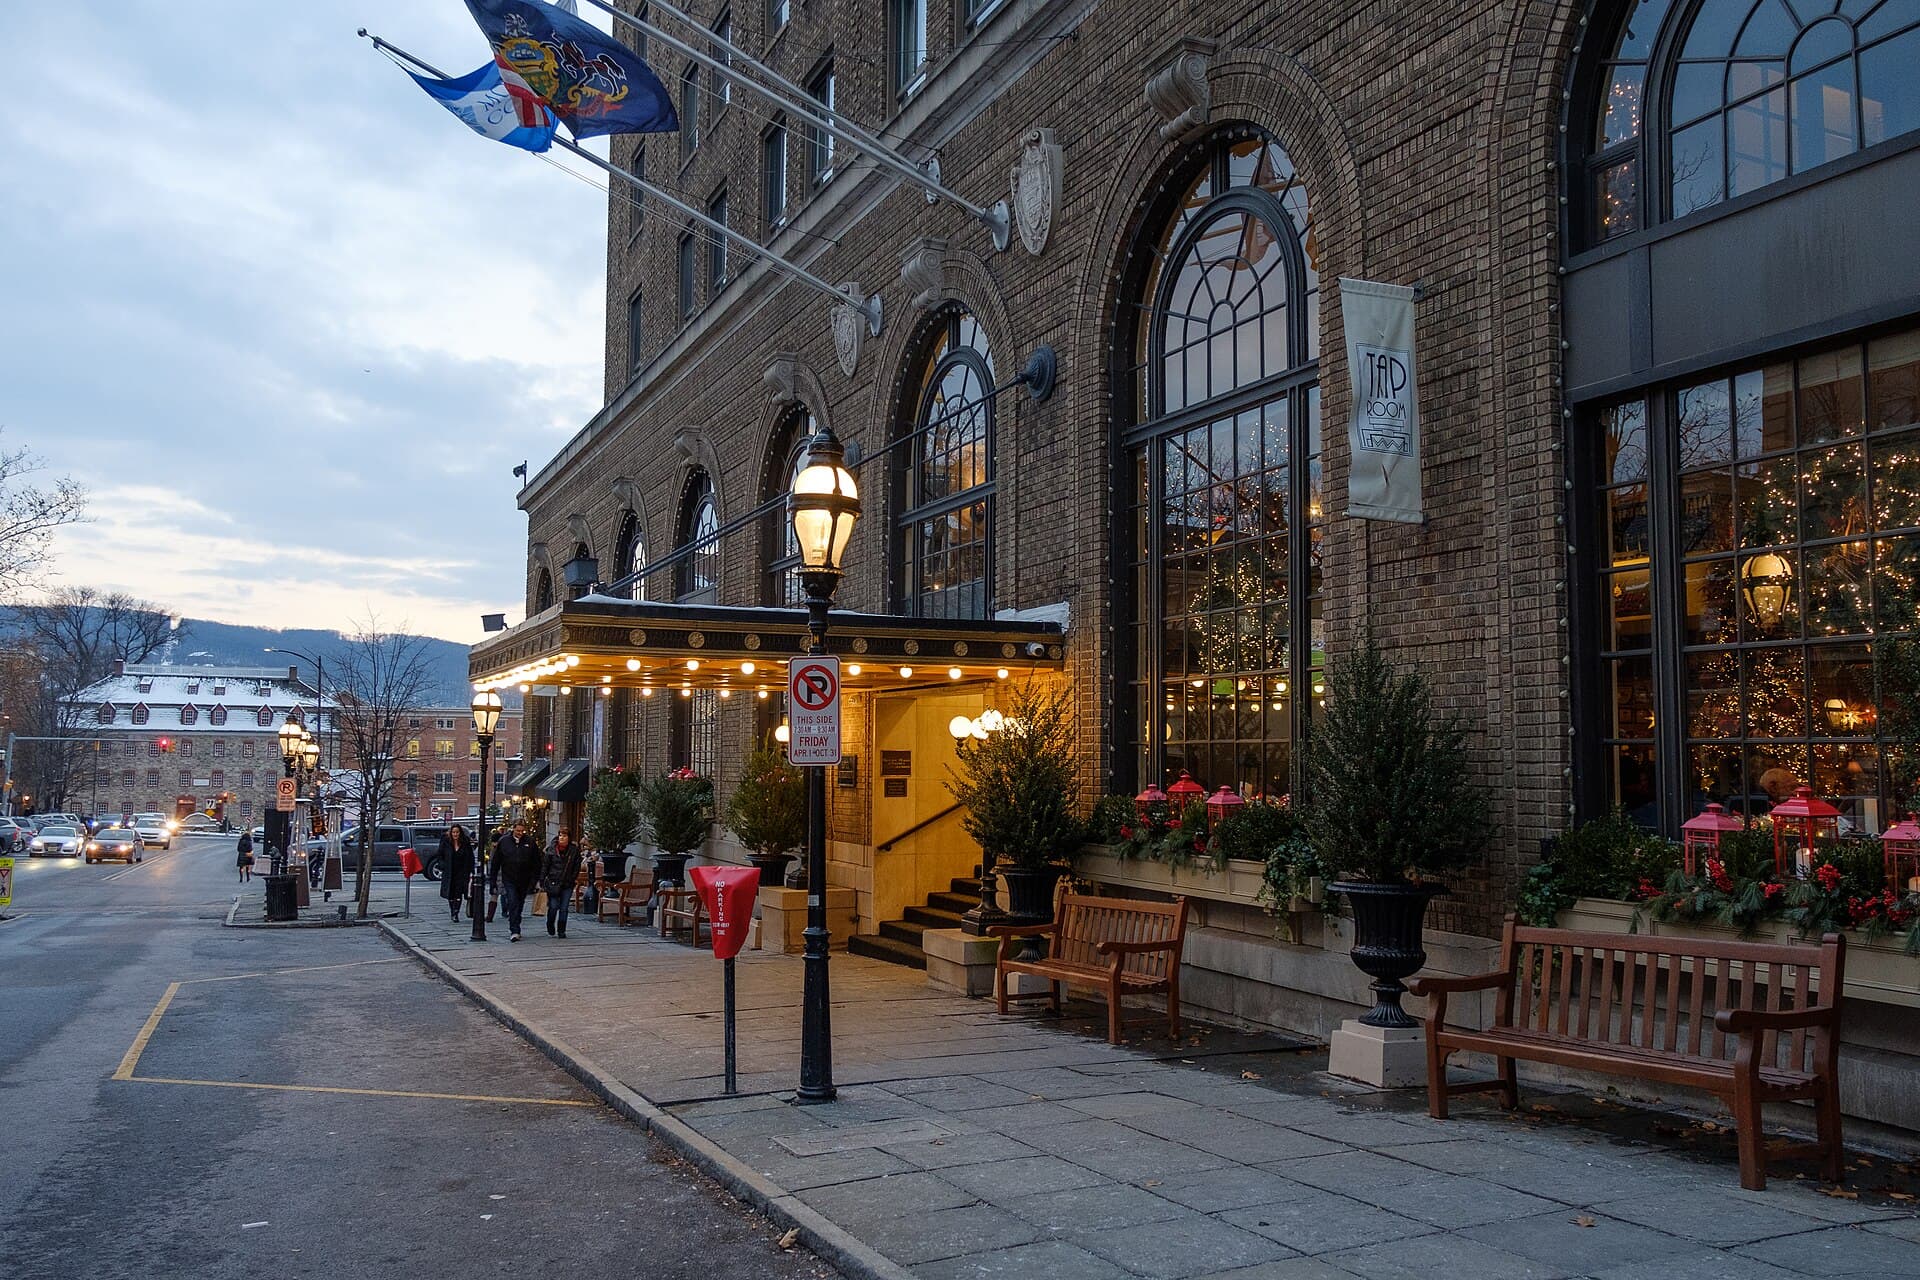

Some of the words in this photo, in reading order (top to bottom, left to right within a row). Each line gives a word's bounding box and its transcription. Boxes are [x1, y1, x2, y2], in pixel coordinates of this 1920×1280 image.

[1366, 352, 1407, 399] TAP
[1366, 400, 1407, 419] ROOM
[797, 716, 813, 724] THIS
[817, 716, 833, 724] SIDE
[799, 736, 828, 747] FRIDAY
